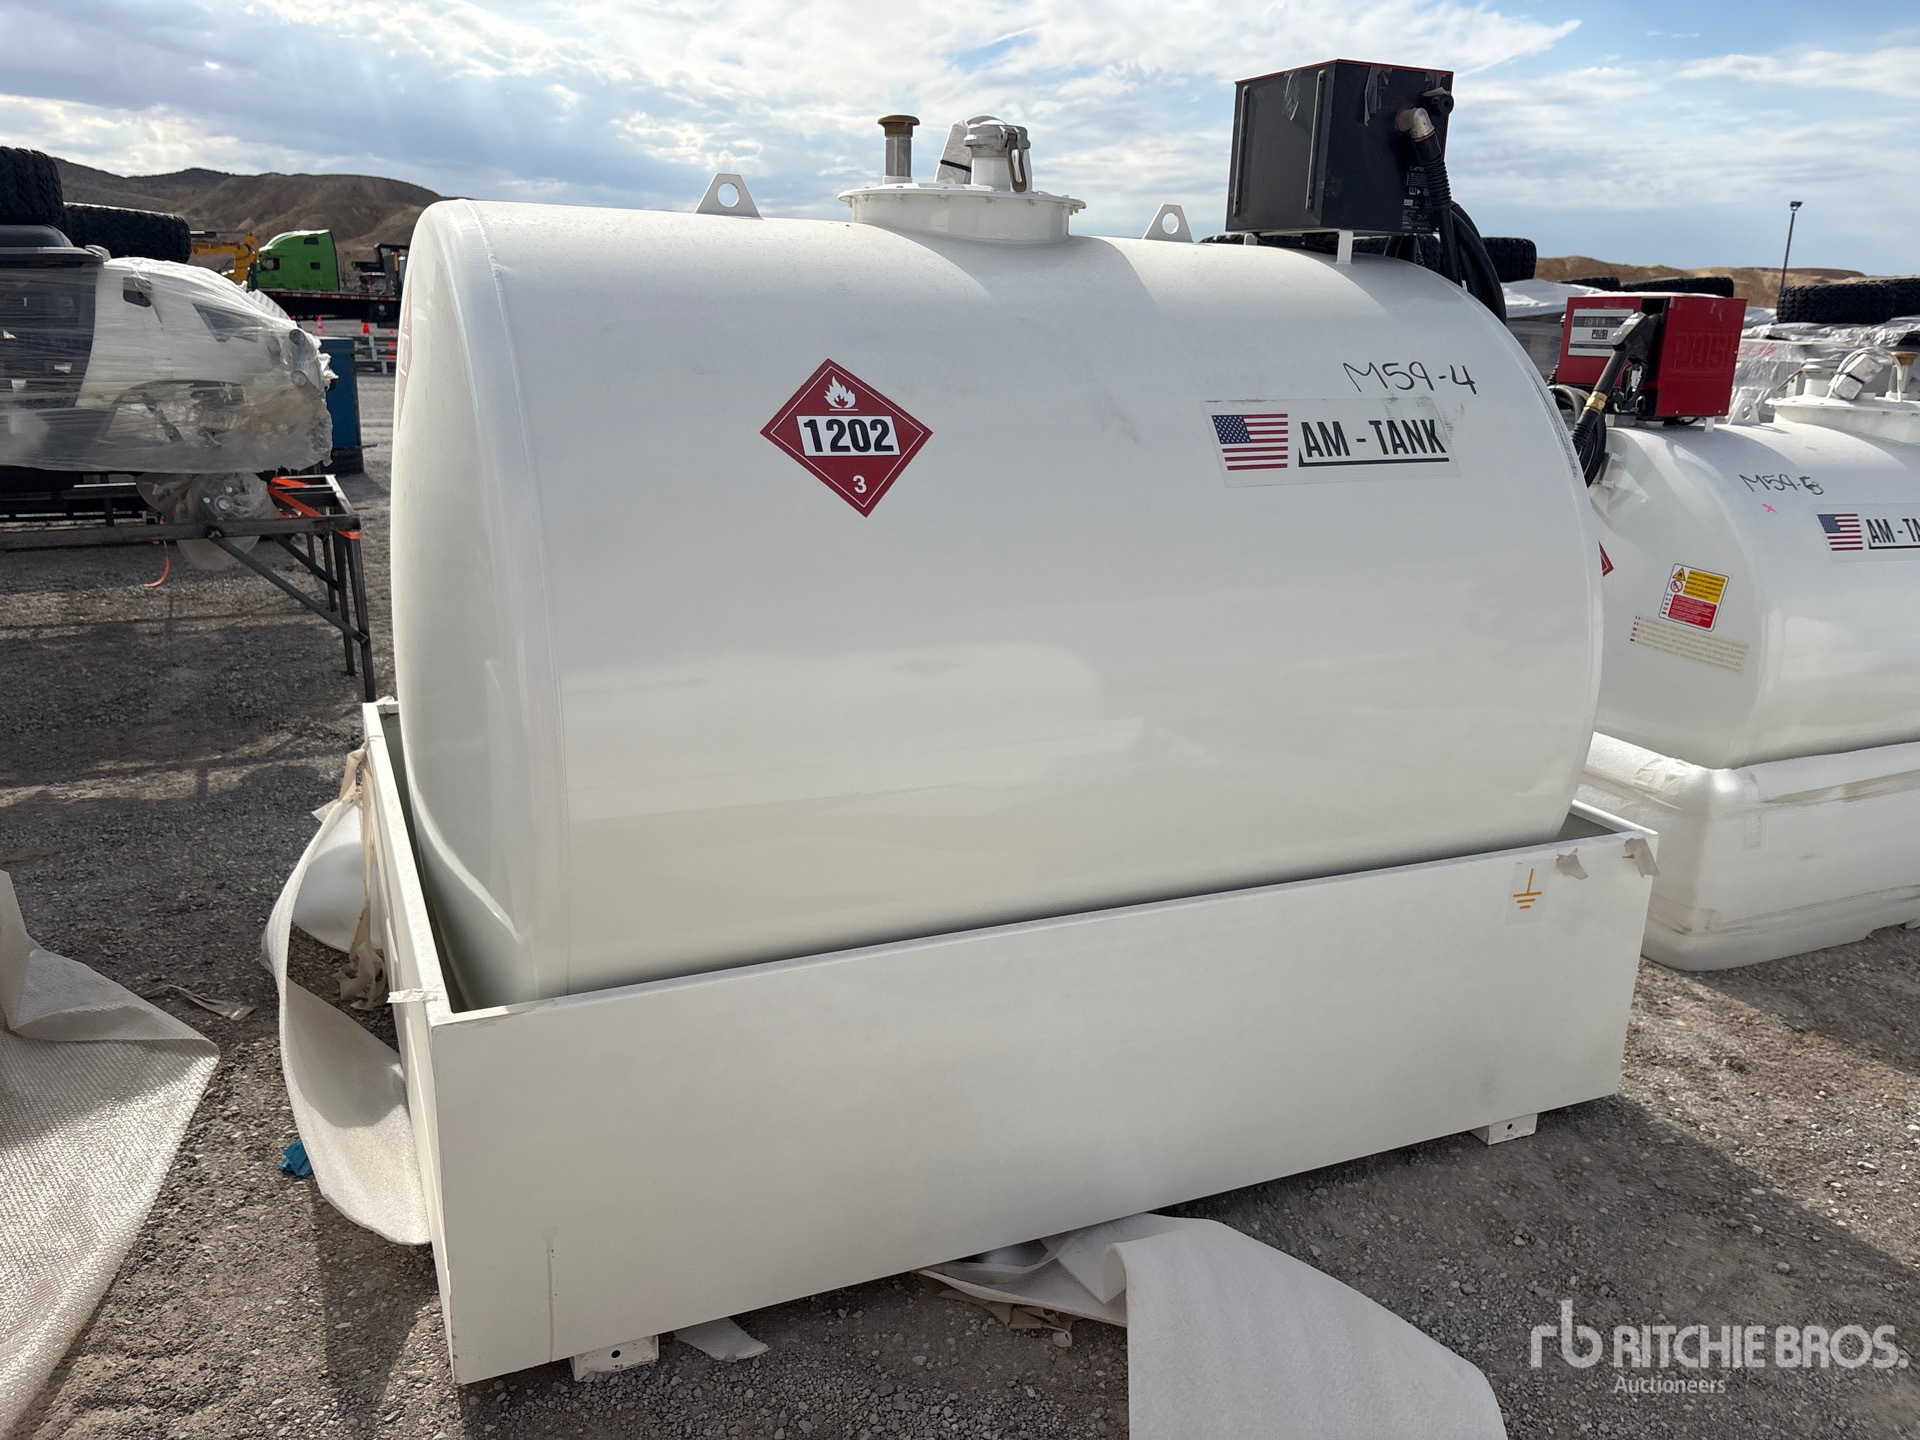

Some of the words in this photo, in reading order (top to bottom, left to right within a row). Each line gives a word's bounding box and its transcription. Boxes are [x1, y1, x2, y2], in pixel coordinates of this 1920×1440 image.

[1342, 361, 1477, 395] M59-4
[803, 418, 895, 453] 1202
[1300, 421, 1351, 458] AM
[1368, 418, 1447, 456] TANK
[852, 474, 868, 494] 3
[1865, 518, 1896, 543] AM
